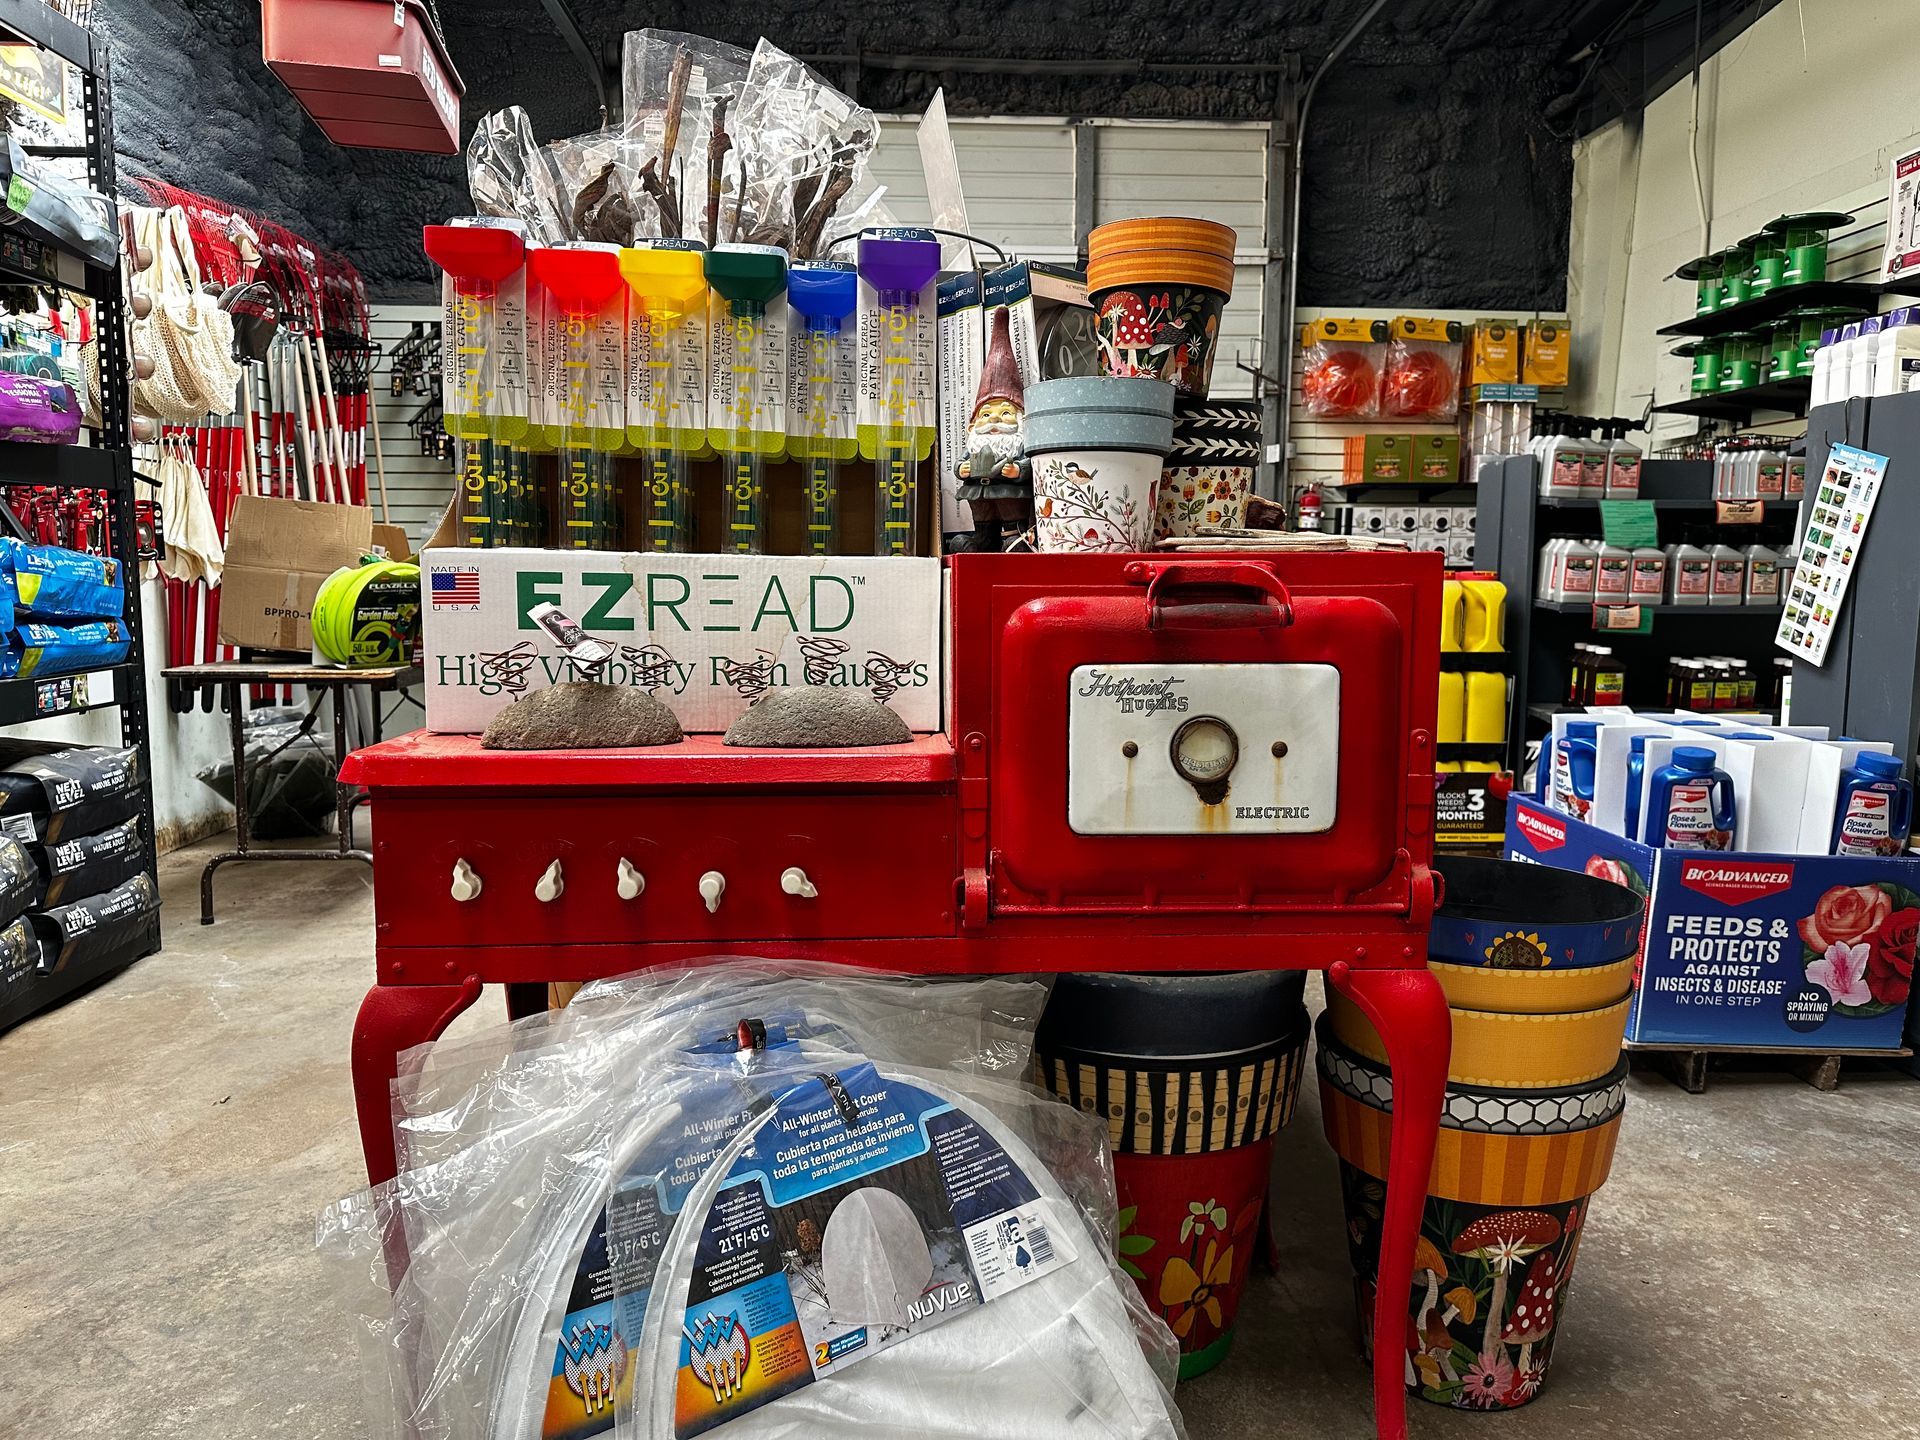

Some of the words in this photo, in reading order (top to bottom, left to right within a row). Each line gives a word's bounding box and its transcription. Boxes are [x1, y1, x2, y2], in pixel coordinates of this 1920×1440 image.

[648, 239, 690, 249] EZREAD
[875, 229, 918, 239] EZREAD
[804, 261, 843, 271] EZREAD
[461, 294, 480, 321] 5
[568, 312, 586, 337] 5
[651, 316, 667, 337] 5
[888, 306, 907, 332] 5
[736, 317, 754, 342] 5
[812, 331, 828, 354] 5
[465, 465, 485, 491] 3
[570, 472, 589, 497] 3
[652, 472, 669, 497] 3
[736, 476, 752, 500] 3
[888, 472, 907, 497] 3
[812, 479, 828, 502] 3
[357, 611, 382, 621] Garden
[382, 610, 399, 621] Hose
[1079, 669, 1185, 717] Hotpoint
[56, 778, 81, 794] NEXT
[1437, 792, 1466, 800] BLOCKS
[56, 790, 86, 806] LEVEL
[1466, 788, 1485, 811] 3
[1235, 806, 1310, 819] ELECTRIC
[1436, 811, 1485, 820] MONTHS
[1671, 814, 1690, 823] Rose
[1670, 821, 1697, 829] Flower
[1697, 821, 1713, 829] Care
[1845, 825, 1871, 835] Flower
[1872, 828, 1888, 836] Care
[1846, 819, 1866, 828] Rose
[56, 841, 81, 857] NEXT
[56, 852, 87, 868] LEVEL
[67, 906, 90, 922] NEXT
[66, 916, 96, 933] LEVEL
[1666, 915, 1763, 938] FEEDS
[1769, 918, 1789, 939] &
[1669, 937, 1781, 964] PROTECTS
[1684, 963, 1761, 977] AGAINST
[1654, 976, 1710, 993] INSECTS
[1713, 980, 1723, 993] &
[1675, 994, 1689, 1005] IN
[1694, 995, 1722, 1006] ONE
[1731, 996, 1761, 1007] STEP
[1786, 1001, 1829, 1013] SPRAYING
[1799, 992, 1820, 1002] NO
[1788, 1012, 1799, 1022] OR
[1798, 1012, 1825, 1022] MIXING
[782, 1109, 833, 1134] All-Winter
[860, 1090, 888, 1107] Cover
[684, 1114, 740, 1138] All-Winter
[798, 1130, 810, 1138] for
[811, 1126, 820, 1135] all
[820, 1118, 842, 1132] plants
[776, 1140, 822, 1163] Cubierta
[822, 1132, 846, 1149] para
[845, 1119, 884, 1140] heladas
[885, 1112, 906, 1129] para
[674, 1147, 723, 1170] Cubierta
[773, 1164, 798, 1180] toda
[799, 1159, 810, 1171] la
[811, 1140, 863, 1166] temporada
[865, 1134, 877, 1147] de
[878, 1122, 915, 1143] invierno
[811, 1168, 828, 1180] para
[828, 1157, 855, 1173] plantas
[854, 1155, 860, 1164] y
[859, 1144, 889, 1161] arbustos
[670, 1171, 693, 1186] toda
[719, 1224, 770, 1255] 21°F/-6°C
[705, 1259, 732, 1273] Generation
[736, 1248, 760, 1261] Synthetic
[712, 1264, 740, 1277] Technology
[740, 1256, 757, 1267] Covers
[708, 1275, 732, 1287] Cubiertas
[733, 1272, 760, 1285] Generation
[907, 1281, 972, 1323] NuVue
[814, 1340, 832, 1369] 2
